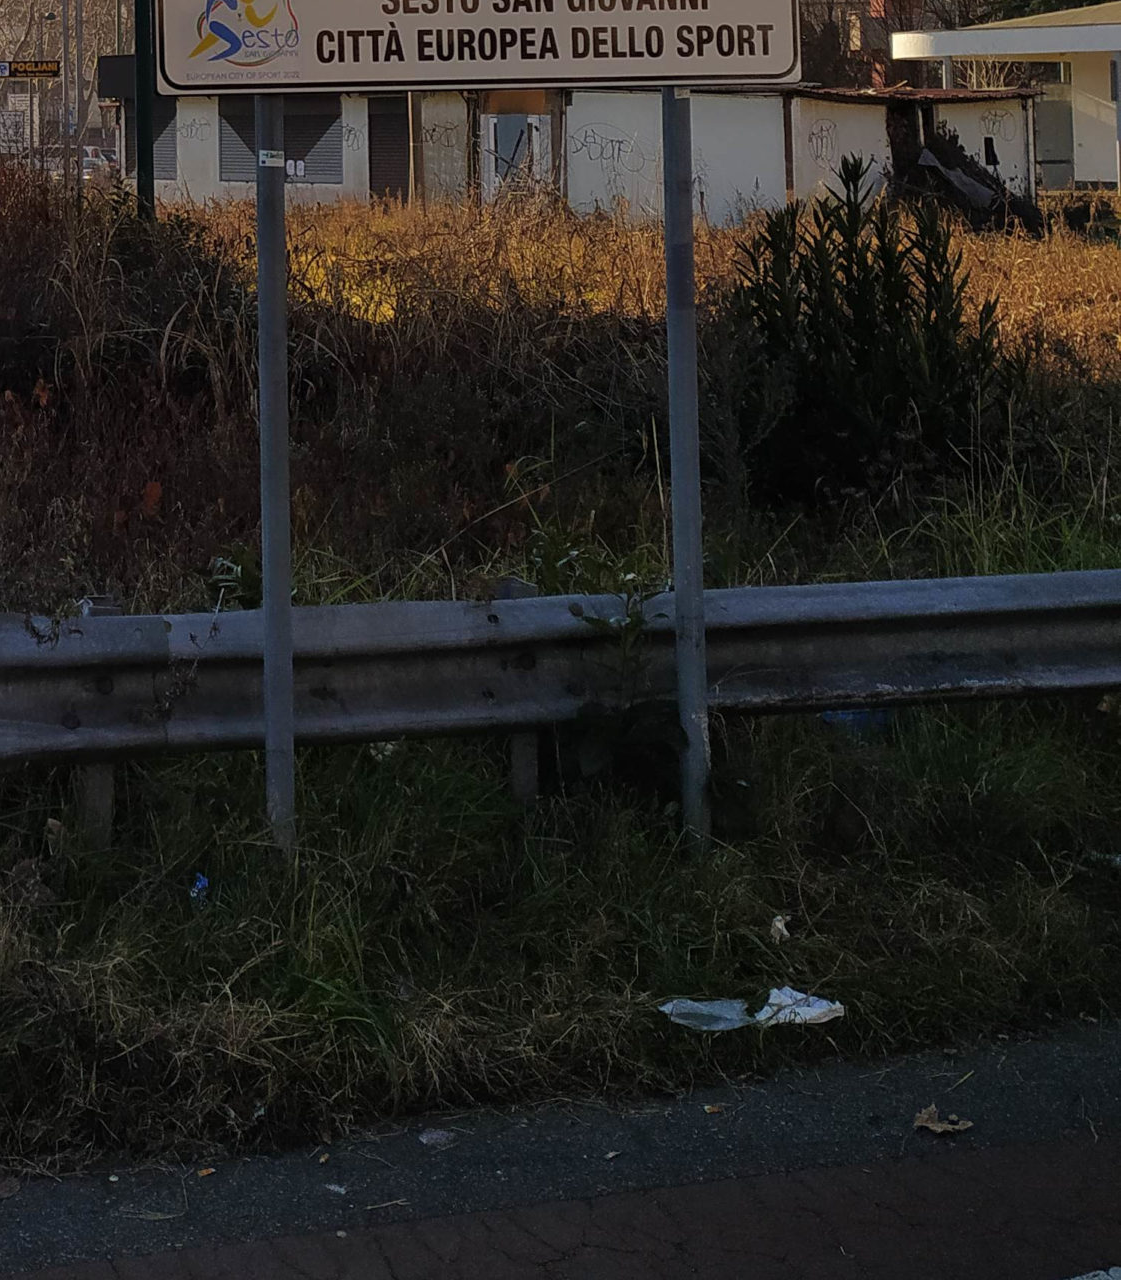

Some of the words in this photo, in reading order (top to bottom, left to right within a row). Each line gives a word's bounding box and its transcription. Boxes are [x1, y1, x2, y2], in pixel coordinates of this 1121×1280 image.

[315, 21, 406, 63] CITTÀ
[417, 27, 560, 63] EUROPEA
[571, 25, 665, 60] DELLO
[676, 23, 775, 58] SPORT
[11, 62, 58, 71] POGLIANI
